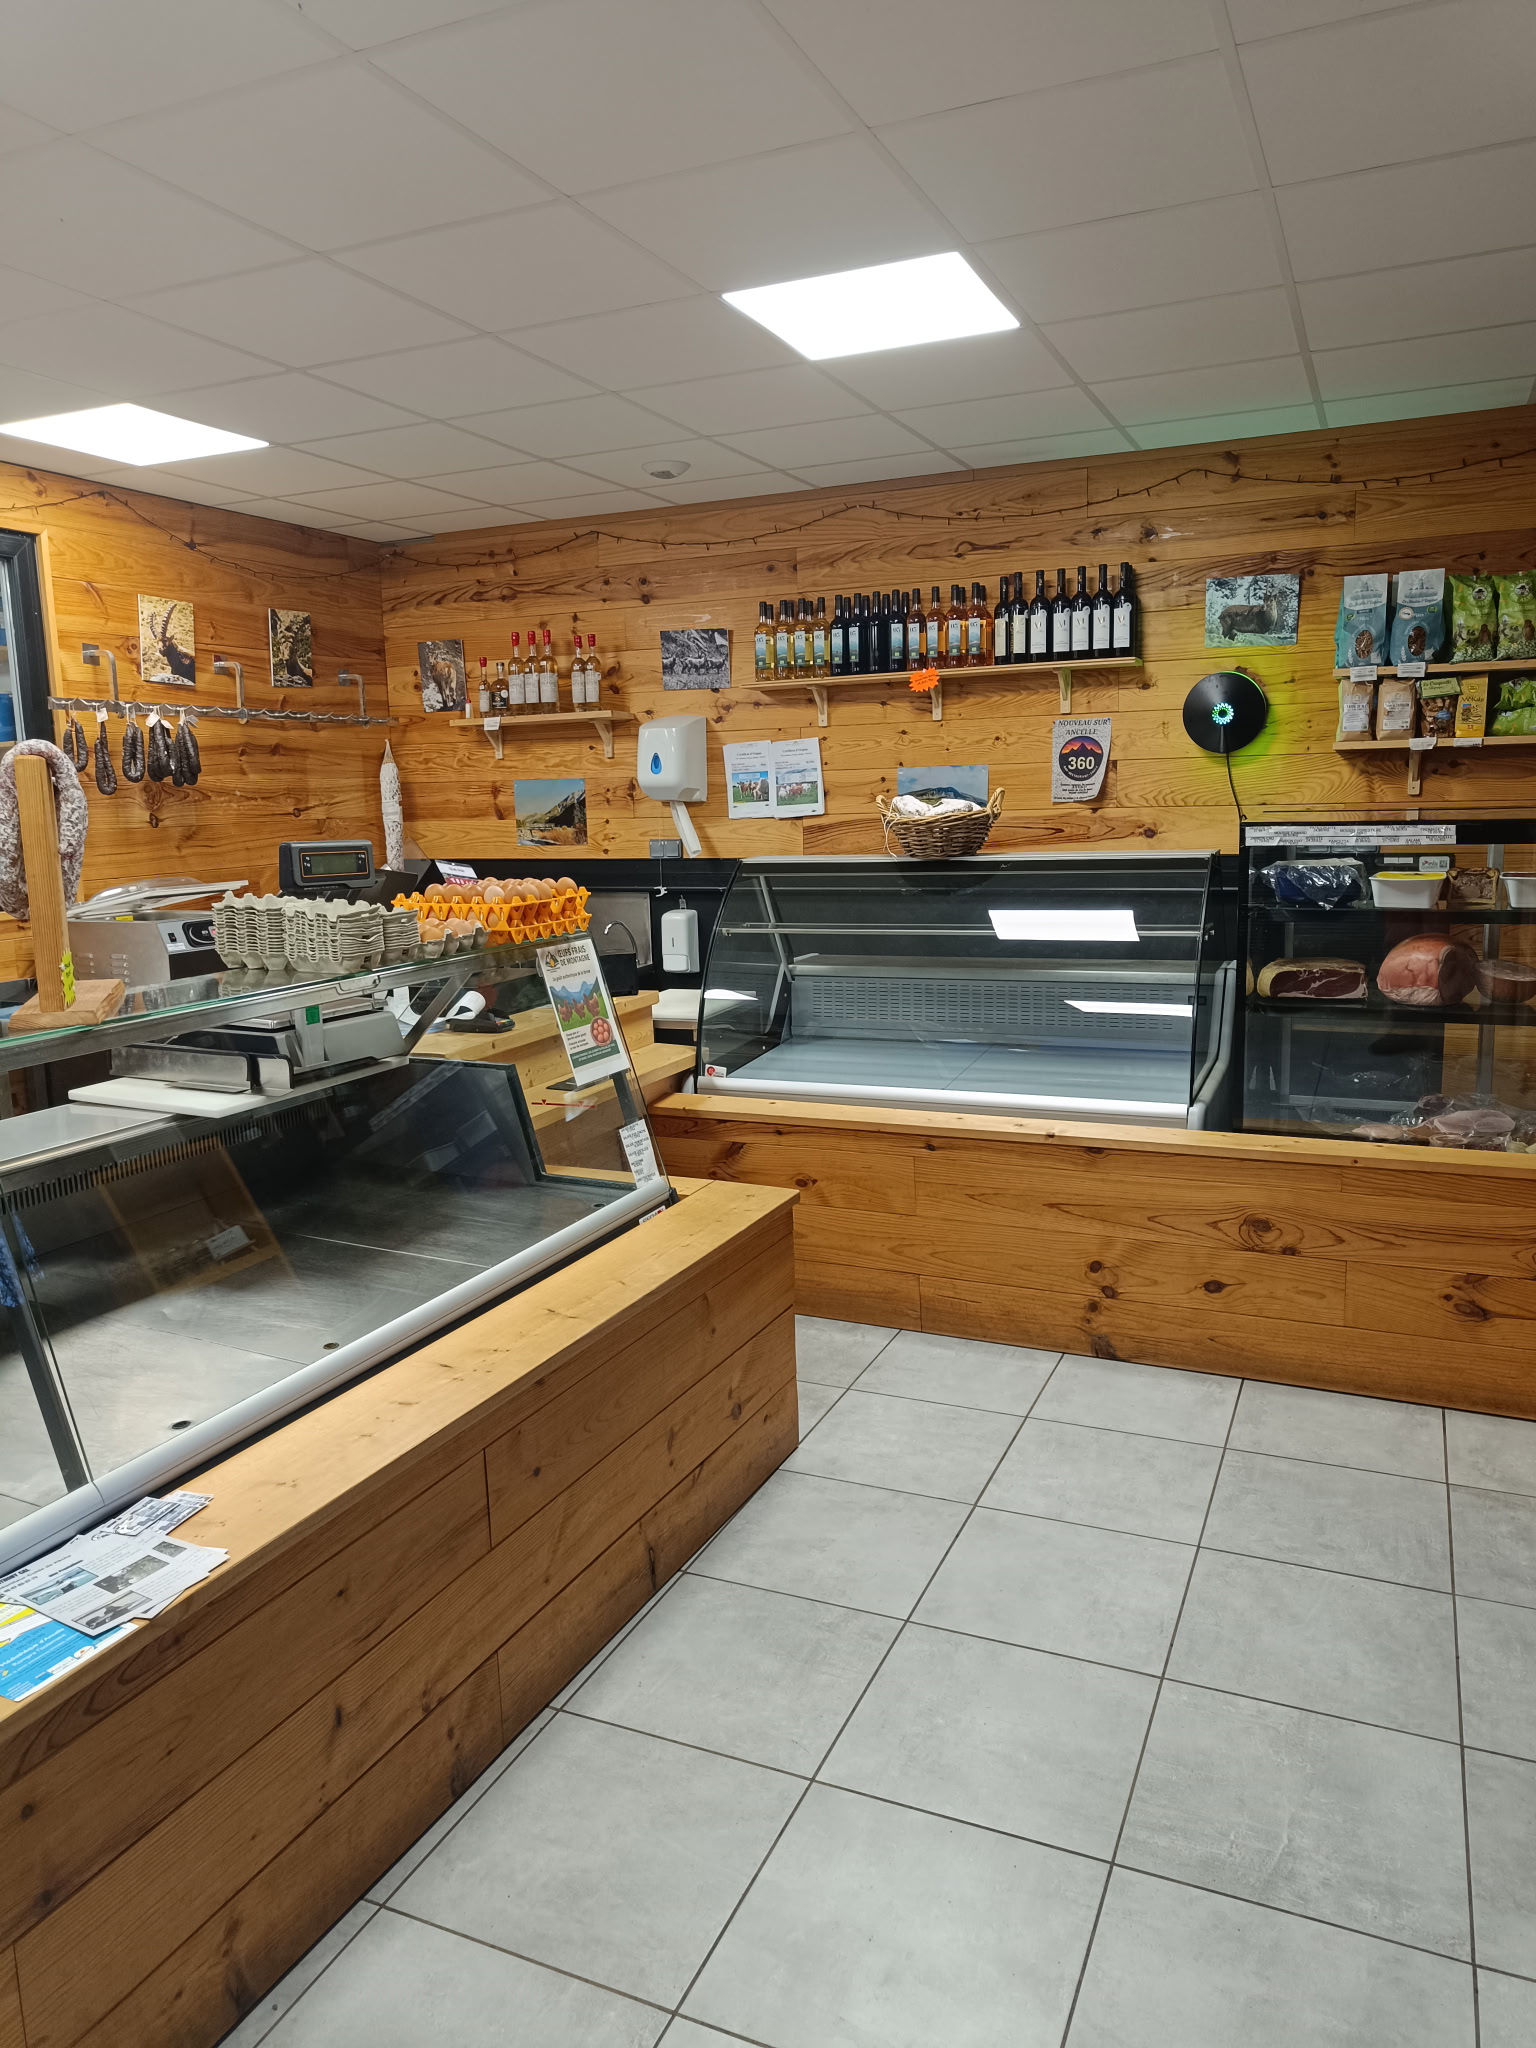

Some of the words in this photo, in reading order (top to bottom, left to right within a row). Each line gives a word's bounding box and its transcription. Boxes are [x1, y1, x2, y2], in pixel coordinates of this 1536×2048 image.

[1065, 728, 1098, 736] ANCELLE
[1068, 756, 1095, 770] 360
[557, 948, 571, 957] ŒUFS
[571, 945, 586, 955] FRAIS
[567, 954, 590, 965] MONTAGNE
